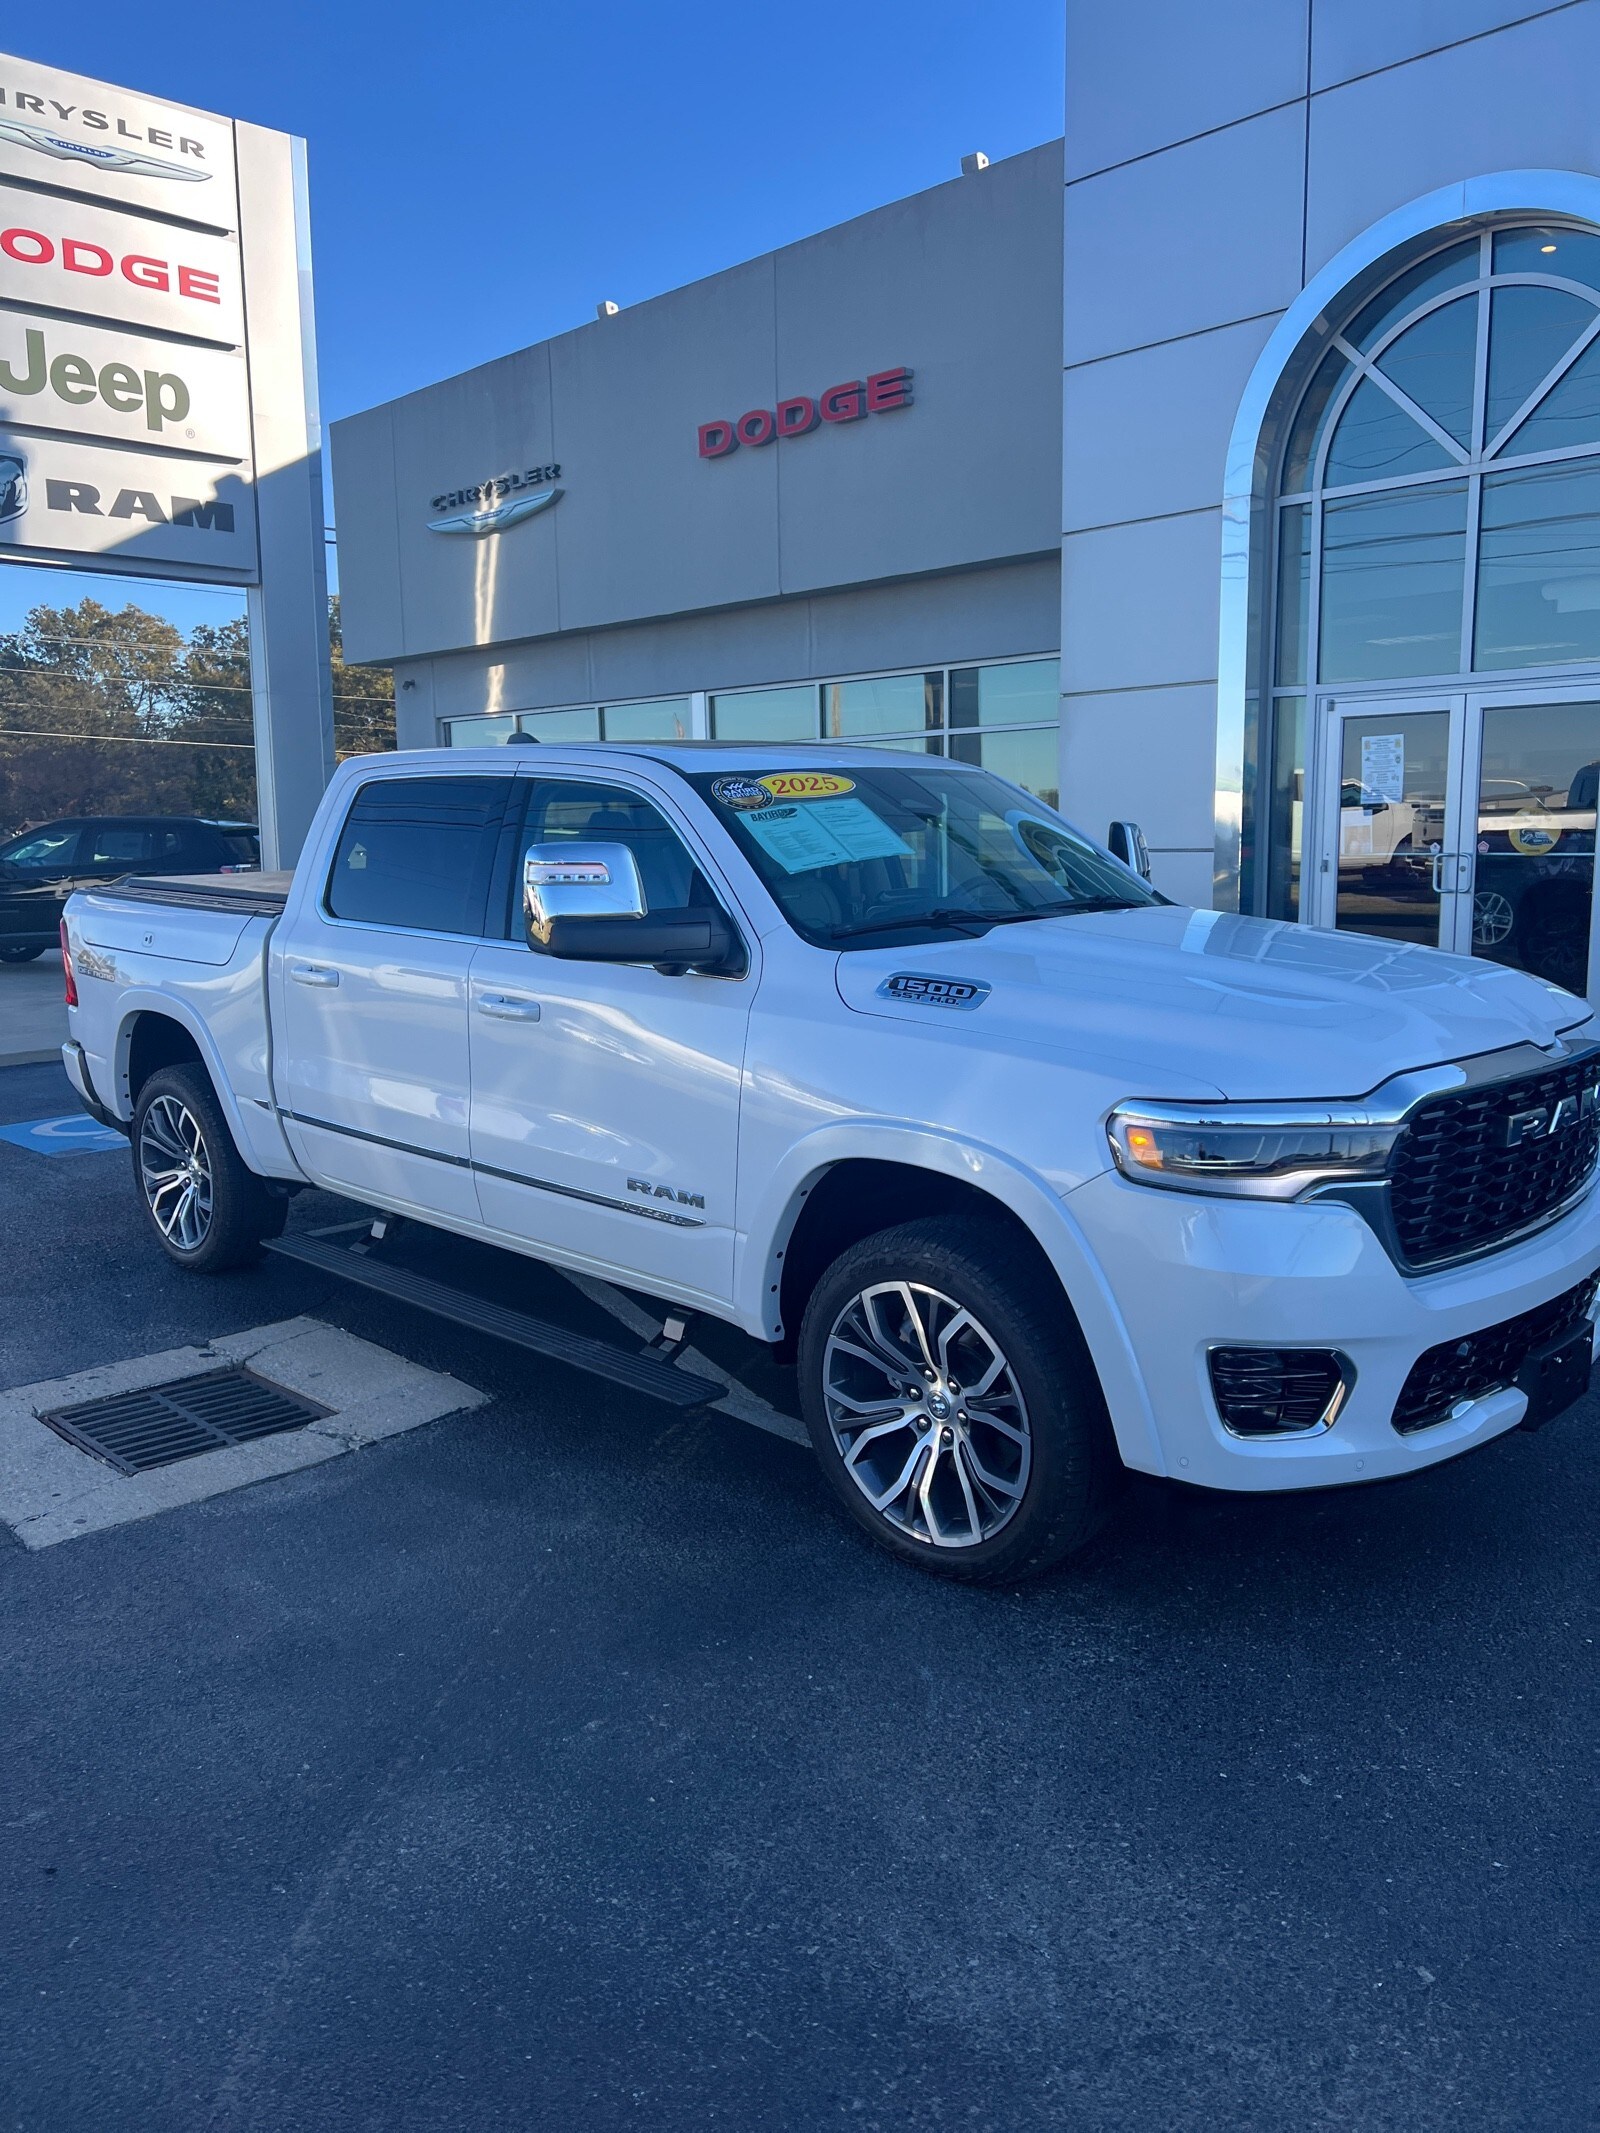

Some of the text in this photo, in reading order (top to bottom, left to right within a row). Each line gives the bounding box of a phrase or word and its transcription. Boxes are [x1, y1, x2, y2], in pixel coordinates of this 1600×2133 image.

[0, 87, 206, 160] RYSLER
[52, 140, 107, 157] CHRYSLER
[0, 328, 191, 432] Jeep
[697, 366, 914, 460] DODGE
[46, 479, 235, 533] RAM
[432, 463, 562, 511] CHRYSLER
[771, 776, 840, 795] 2025
[890, 990, 925, 1000] SST
[896, 978, 973, 998] 1500
[626, 1176, 705, 1210] RAM
